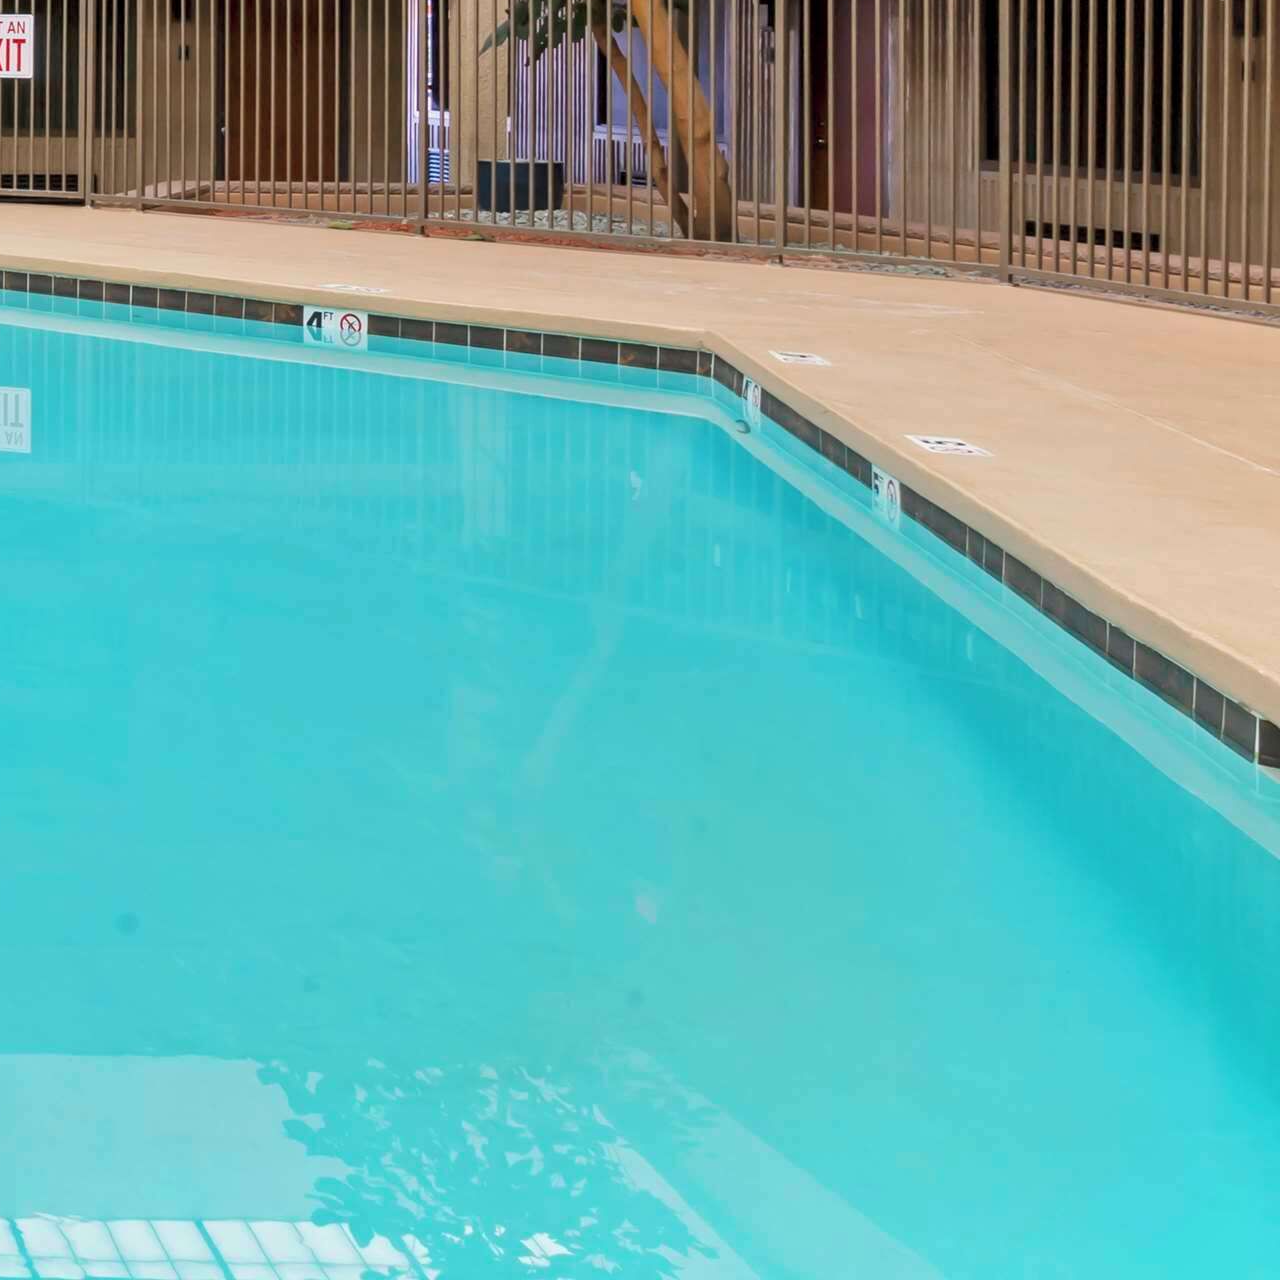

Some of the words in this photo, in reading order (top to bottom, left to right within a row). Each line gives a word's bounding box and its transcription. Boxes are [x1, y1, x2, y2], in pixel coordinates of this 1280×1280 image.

[7, 20, 26, 34] AN
[306, 311, 323, 329] 4
[323, 311, 335, 321] FT
